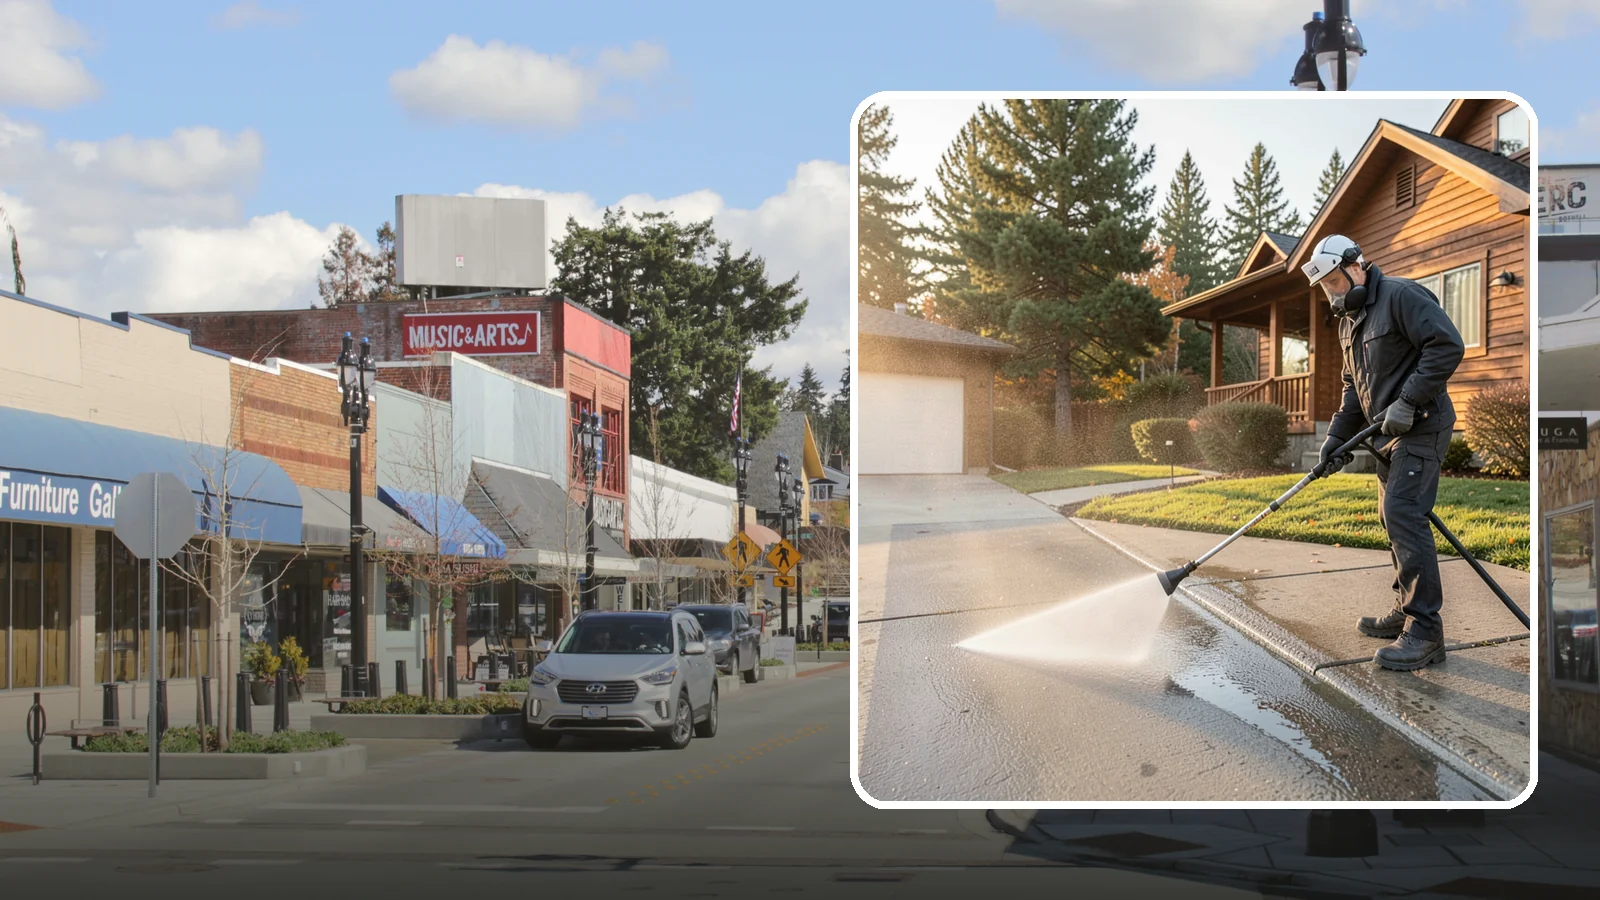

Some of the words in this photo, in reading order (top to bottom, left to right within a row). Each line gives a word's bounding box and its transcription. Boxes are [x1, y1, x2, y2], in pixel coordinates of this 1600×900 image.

[409, 323, 519, 349] MUSIC&ARTS
[1540, 427, 1577, 436] UGA
[0, 471, 79, 515] Furniture
[90, 482, 121, 519] Gal
[452, 562, 479, 574] SUSHI
